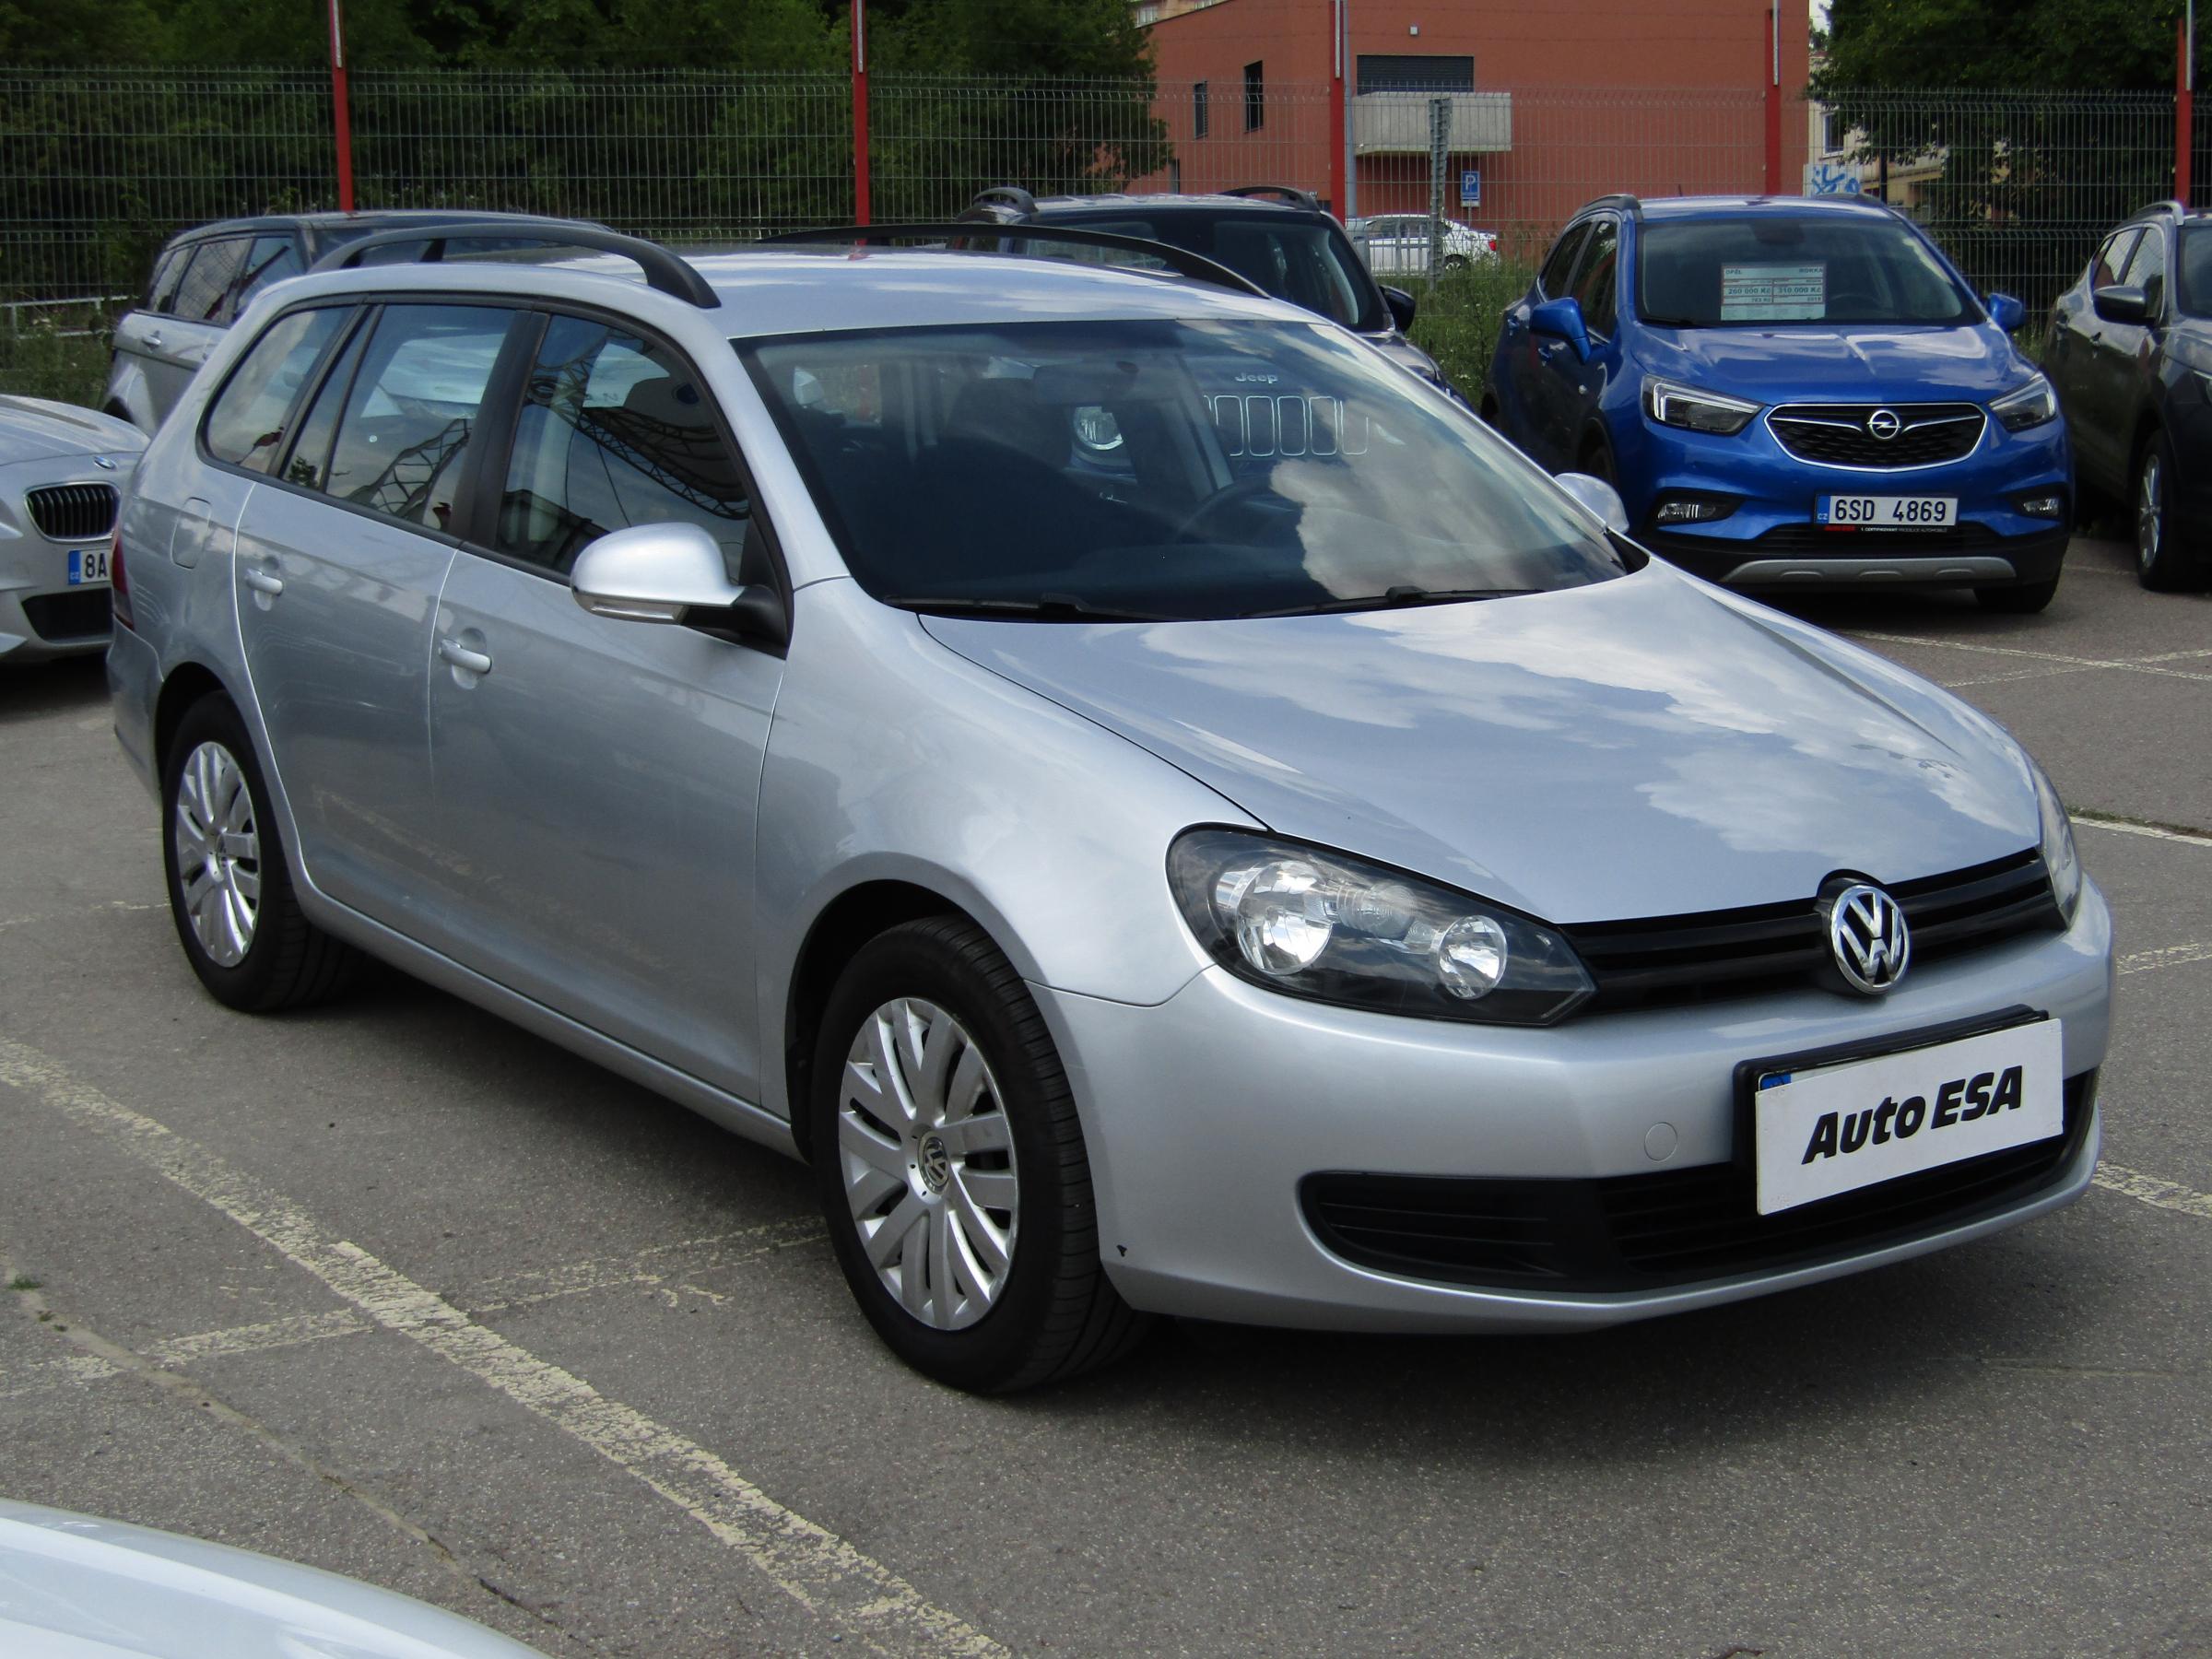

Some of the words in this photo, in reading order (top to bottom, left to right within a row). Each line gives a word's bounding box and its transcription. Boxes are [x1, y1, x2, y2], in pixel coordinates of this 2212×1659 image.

[1234, 371, 1278, 384] Jeep
[1834, 499, 1876, 521] 6SD
[1892, 500, 1947, 523] 4869
[86, 553, 108, 578] 8A
[1801, 1096, 1926, 1165] Auto
[1930, 1065, 2023, 1130] ESA
